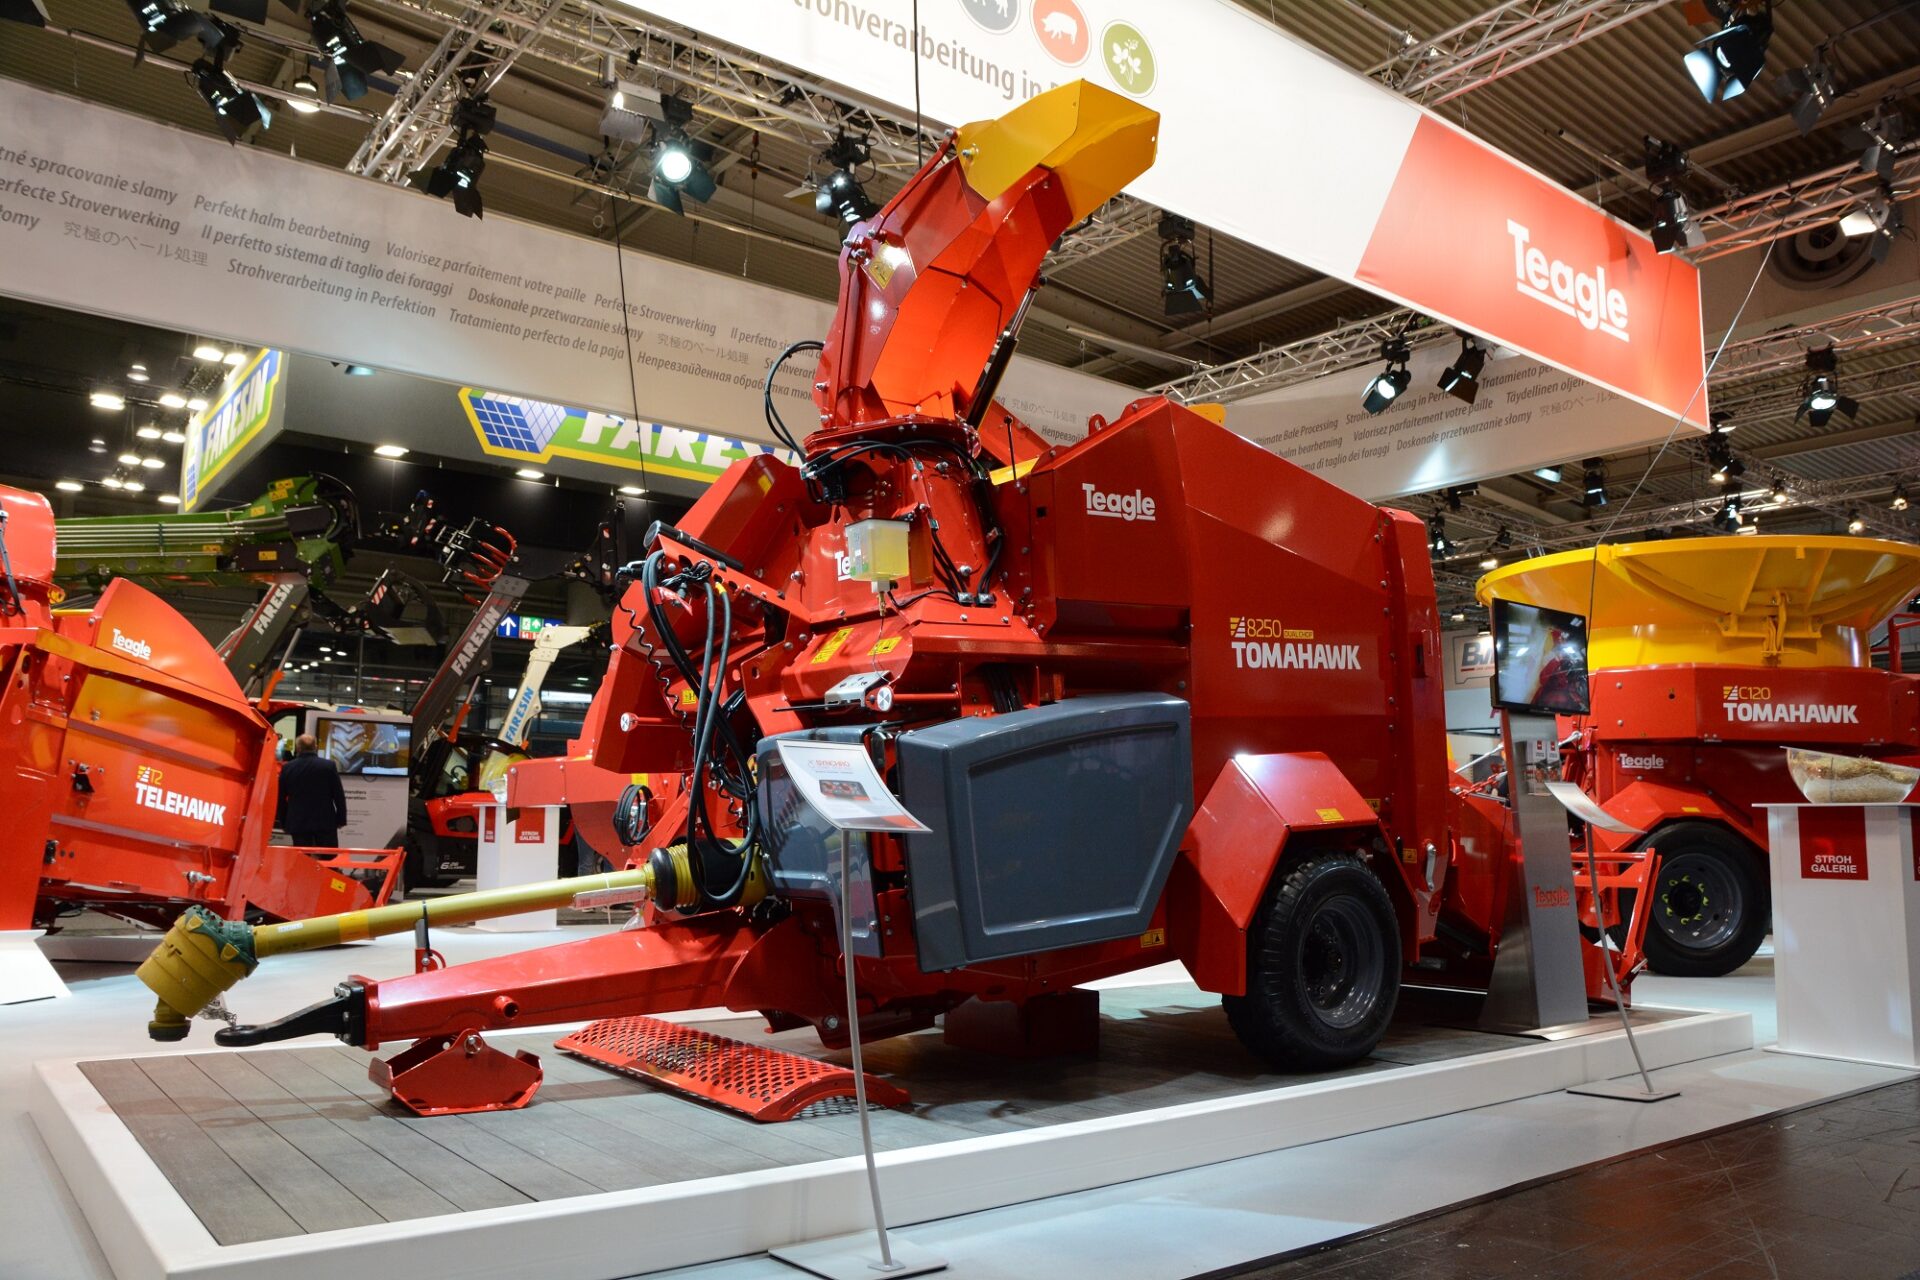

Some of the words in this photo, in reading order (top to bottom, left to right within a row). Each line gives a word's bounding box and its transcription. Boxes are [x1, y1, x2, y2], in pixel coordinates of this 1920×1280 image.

[29, 155, 129, 193] spracovanie
[130, 179, 178, 206] slamy
[194, 194, 248, 221] Perfekt
[249, 207, 285, 230] halm
[288, 217, 370, 254] bearbetning
[386, 241, 442, 268] Valorisez
[441, 260, 522, 288] parfaitement
[523, 277, 553, 295] votre
[554, 285, 587, 303] paille
[639, 304, 717, 337] Stroverwerking
[738, 332, 778, 350] perfetto
[59, 190, 181, 235] Stroverwerking
[213, 228, 272, 254] perfetto
[275, 243, 327, 267] sistema
[330, 255, 343, 271] di
[346, 259, 384, 280] taglio
[386, 267, 406, 285] dei
[407, 272, 454, 298] foraggi
[530, 304, 610, 332] przetwarzanie
[64, 220, 209, 267] 究極のベール処理
[1507, 218, 1630, 332] Teagle
[227, 258, 353, 302] Strohverarbeitung
[355, 286, 368, 302] in
[370, 290, 436, 318] Perfektion
[449, 308, 522, 336] Tratamiento
[522, 327, 570, 347] perfecto
[571, 334, 586, 350] de
[587, 339, 599, 353] la
[600, 346, 625, 360] paja
[203, 359, 270, 473] FARESIN
[1283, 427, 1300, 440] Bale
[1300, 417, 1339, 437] Processing
[1417, 394, 1427, 406] in
[1481, 368, 1537, 389] Tratamiento
[1297, 436, 1343, 456] bearbetning
[1353, 425, 1388, 441] Valorisez
[1388, 412, 1443, 436] parfaitement
[1445, 406, 1467, 418] votre
[1468, 398, 1493, 415] paille
[1325, 453, 1347, 469] taglio
[1348, 450, 1360, 462] dei
[1361, 443, 1390, 460] foraggi
[1440, 416, 1503, 442] przetwarzanie
[1082, 483, 1156, 521] Teagle
[113, 627, 151, 659] Teagle
[450, 605, 501, 677] FARESIN
[1246, 618, 1281, 638] 8250
[1231, 641, 1362, 670] TOMAHAWK
[504, 687, 534, 743] FARESIN
[1723, 702, 1859, 724] TOMAHAWK
[1738, 686, 1771, 700] C120
[1619, 752, 1665, 769] Teagle
[135, 781, 227, 826] TELEHAWK
[1811, 864, 1857, 874] GALERIE
[1814, 854, 1852, 865] STROH
